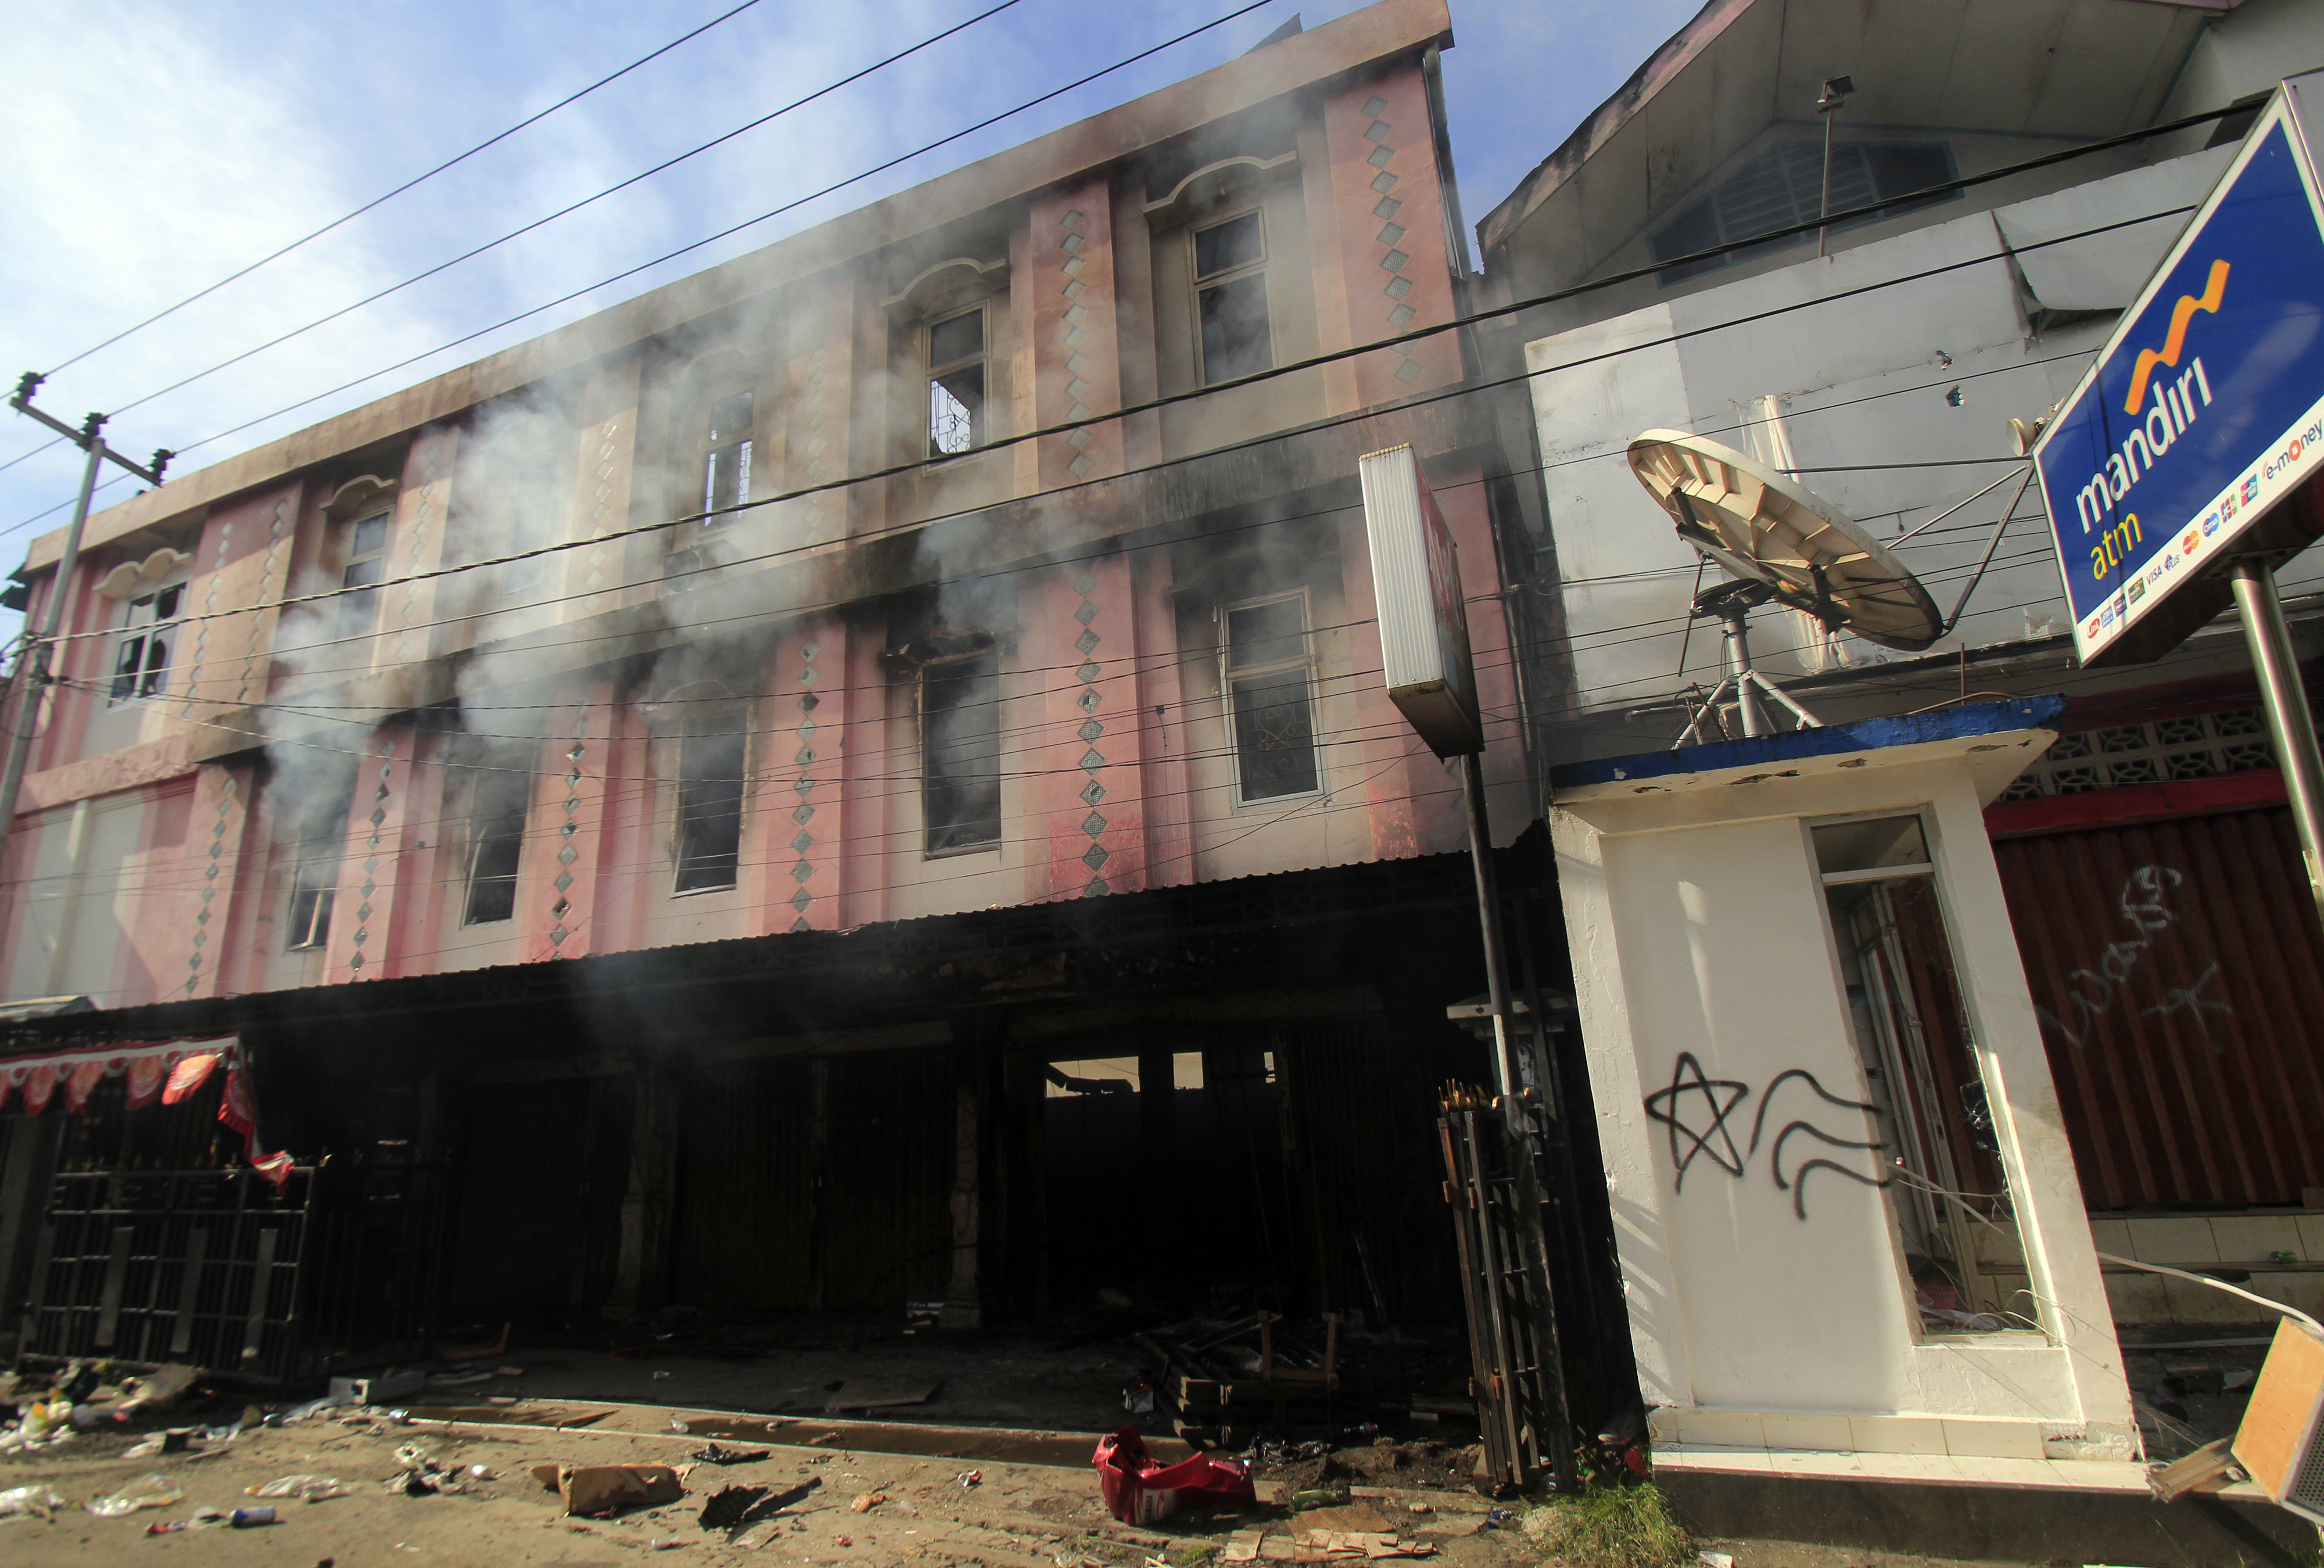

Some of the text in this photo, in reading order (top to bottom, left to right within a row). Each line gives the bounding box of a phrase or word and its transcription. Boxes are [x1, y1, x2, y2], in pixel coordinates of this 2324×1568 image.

[2090, 512, 2143, 580] atm
[2146, 565, 2162, 585] VISA
[2222, 500, 2236, 517] JCB
[2266, 418, 2322, 480] e-money
